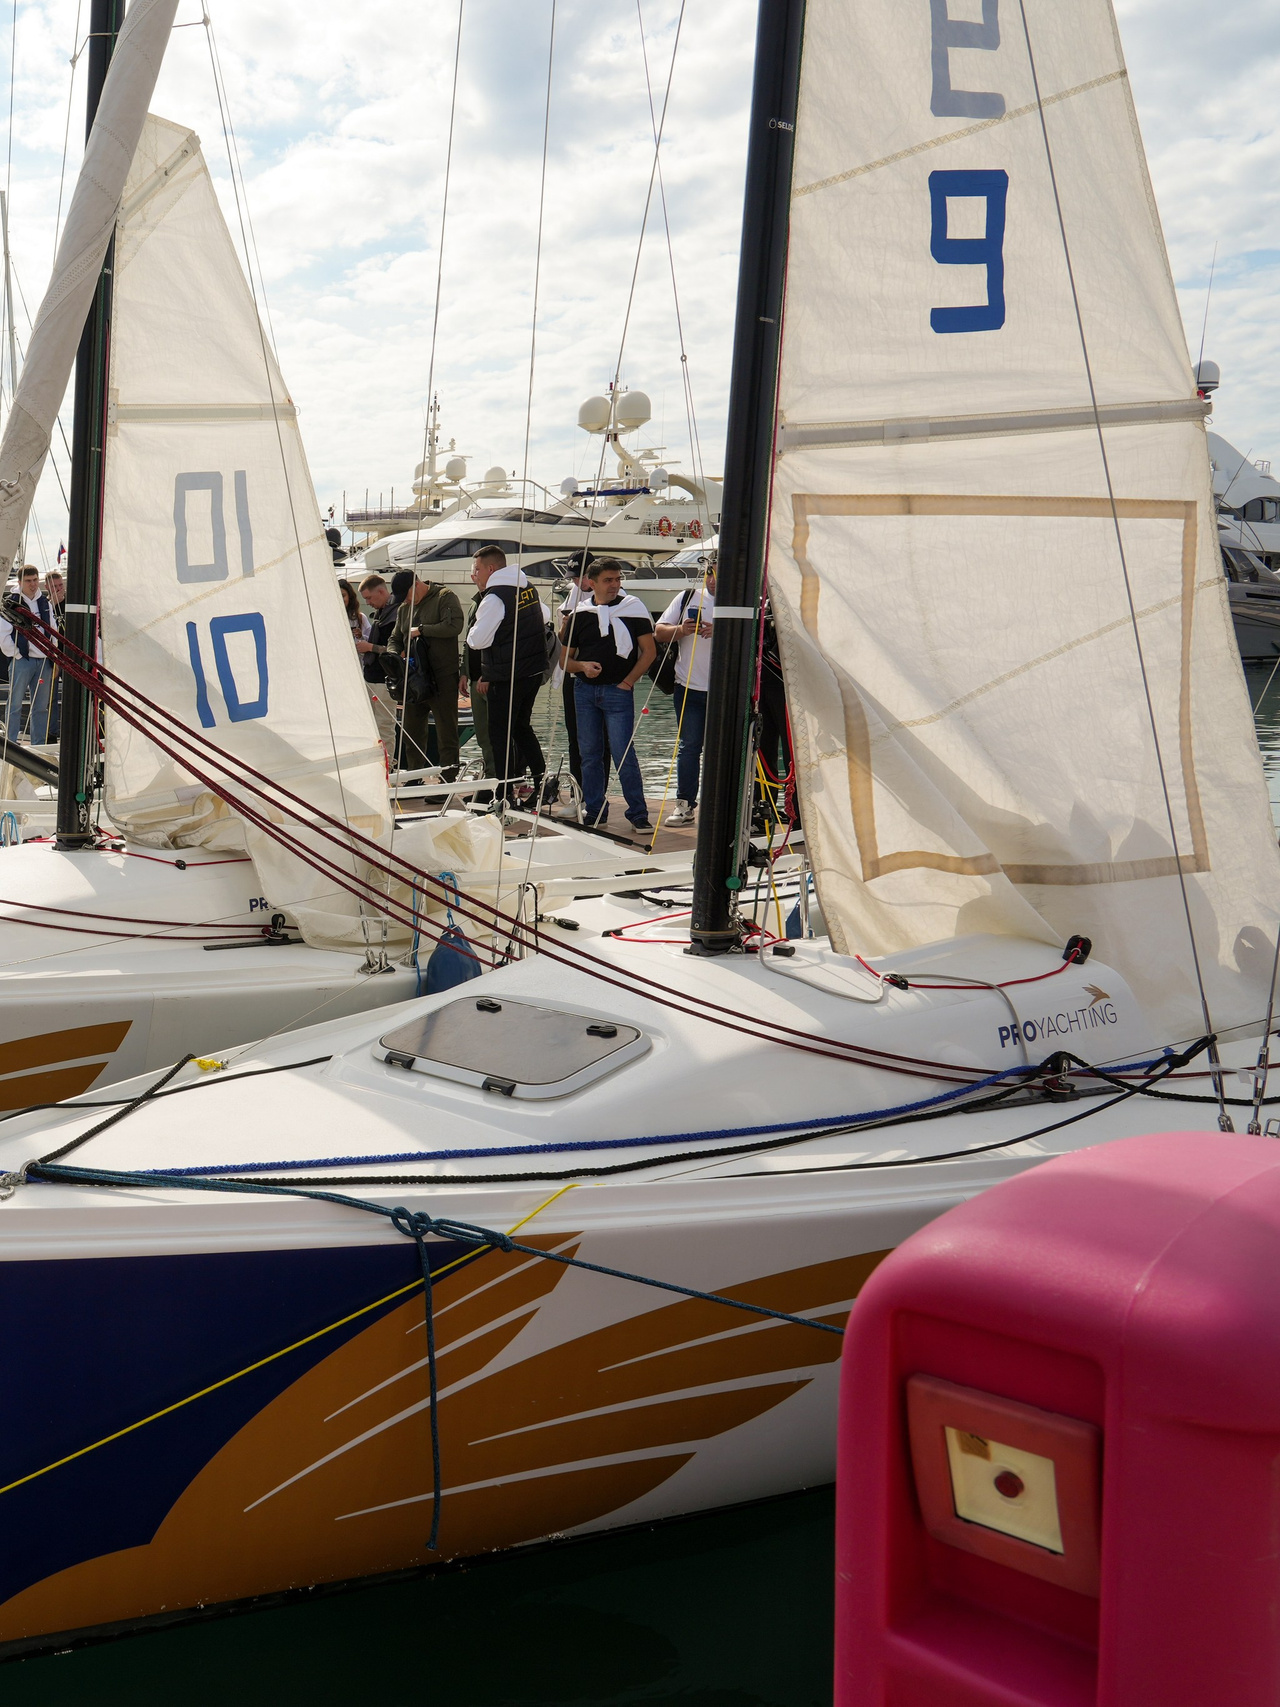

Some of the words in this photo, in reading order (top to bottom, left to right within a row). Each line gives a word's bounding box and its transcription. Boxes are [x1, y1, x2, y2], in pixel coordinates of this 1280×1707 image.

[928, 169, 1009, 334] 9
[186, 612, 269, 729] 10
[999, 1003, 1118, 1048] PROYACHTING
